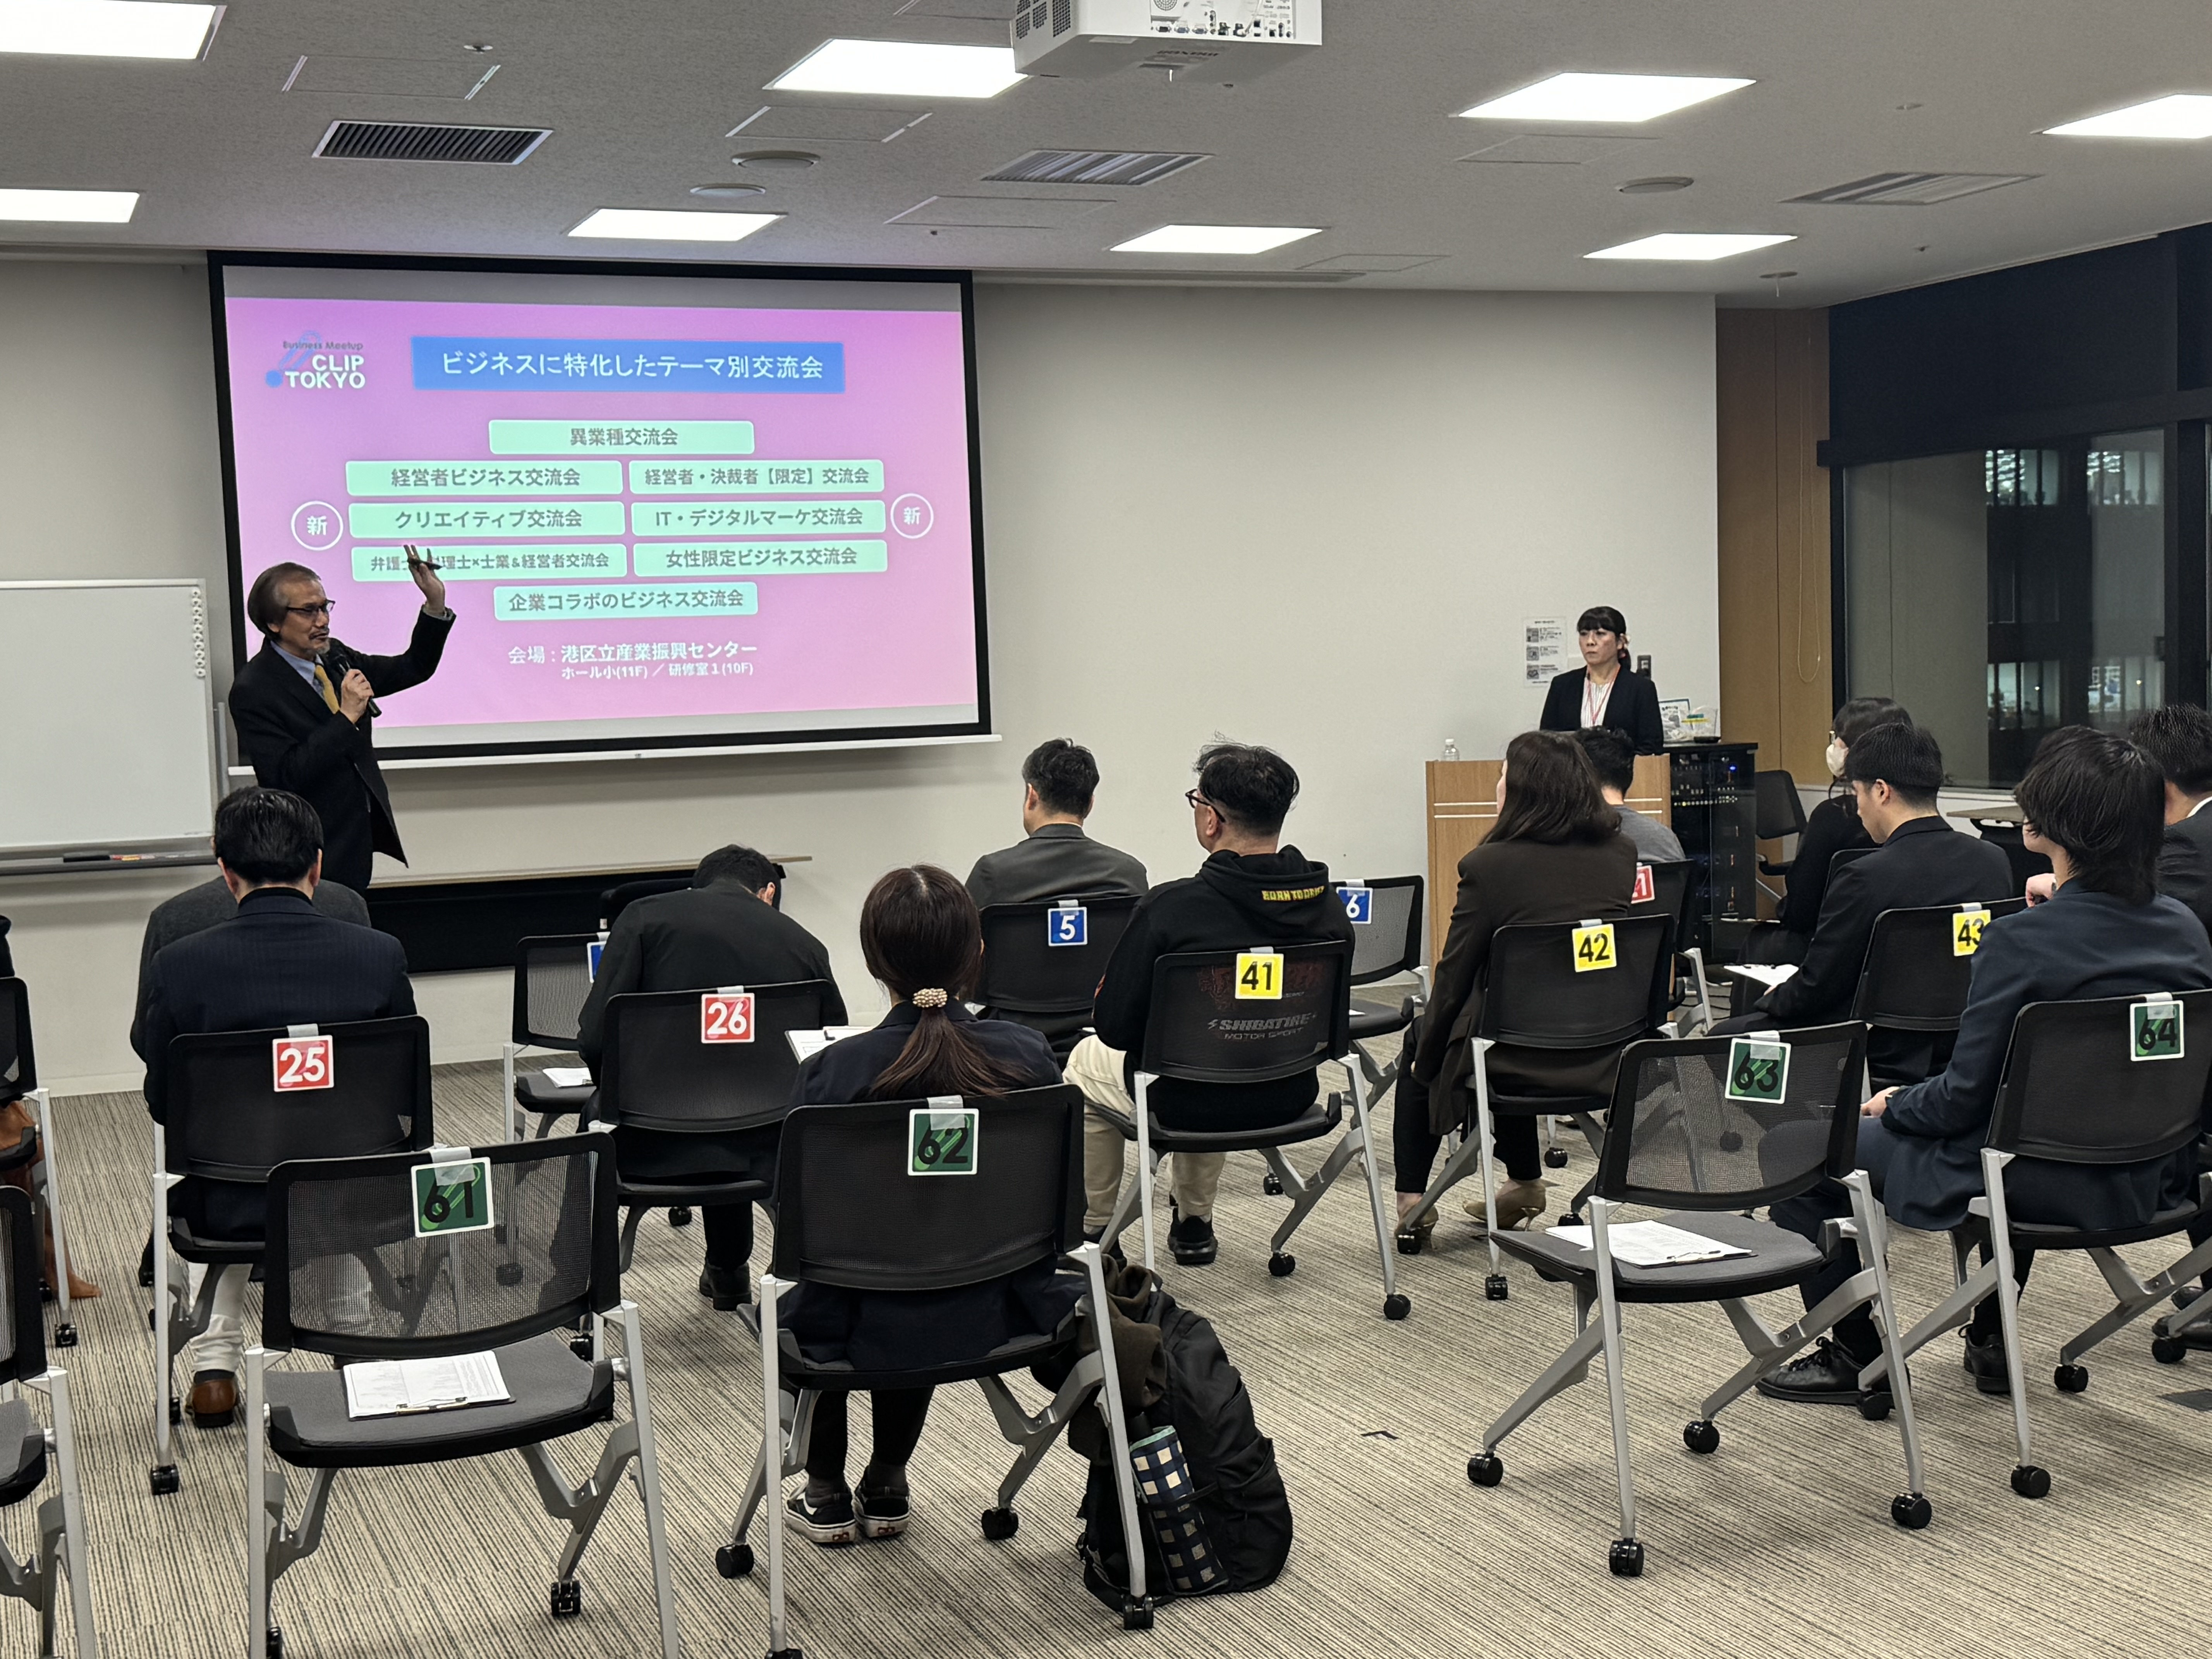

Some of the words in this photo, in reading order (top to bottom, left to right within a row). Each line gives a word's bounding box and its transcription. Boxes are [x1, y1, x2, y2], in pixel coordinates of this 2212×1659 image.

[283, 340, 322, 349] Business
[326, 341, 364, 351] Meetup
[312, 354, 364, 371] CLIP
[443, 350, 823, 379] ビジネスに特化したテーマ別交流会
[284, 371, 366, 389] TOKYO
[570, 428, 678, 447] 異業種交流会
[391, 467, 581, 487] 経営者ビジネス交流会
[644, 467, 870, 486] 経営者・決裁者【限定】交流会
[306, 515, 328, 536] 新
[395, 509, 583, 529] クリエイティブ交流会
[655, 507, 864, 527] IT・デジタルマーケ交流会
[903, 507, 921, 525] 新
[666, 547, 858, 568] 女性限定ビジネス交流会
[508, 589, 744, 611] 企業コラボのビジネス交流会
[1633, 872, 1647, 896] 1
[1346, 894, 1360, 918] 6
[1059, 915, 1075, 940] 5
[1958, 918, 1984, 946] 43
[1578, 933, 1610, 962] 42
[1241, 961, 1273, 991] 41
[707, 1001, 747, 1035] 26
[2138, 1012, 2177, 1050] 64
[279, 1047, 325, 1084] 25
[1734, 1050, 1779, 1092] 63
[917, 1124, 969, 1165] 62
[424, 1177, 474, 1223] 61
